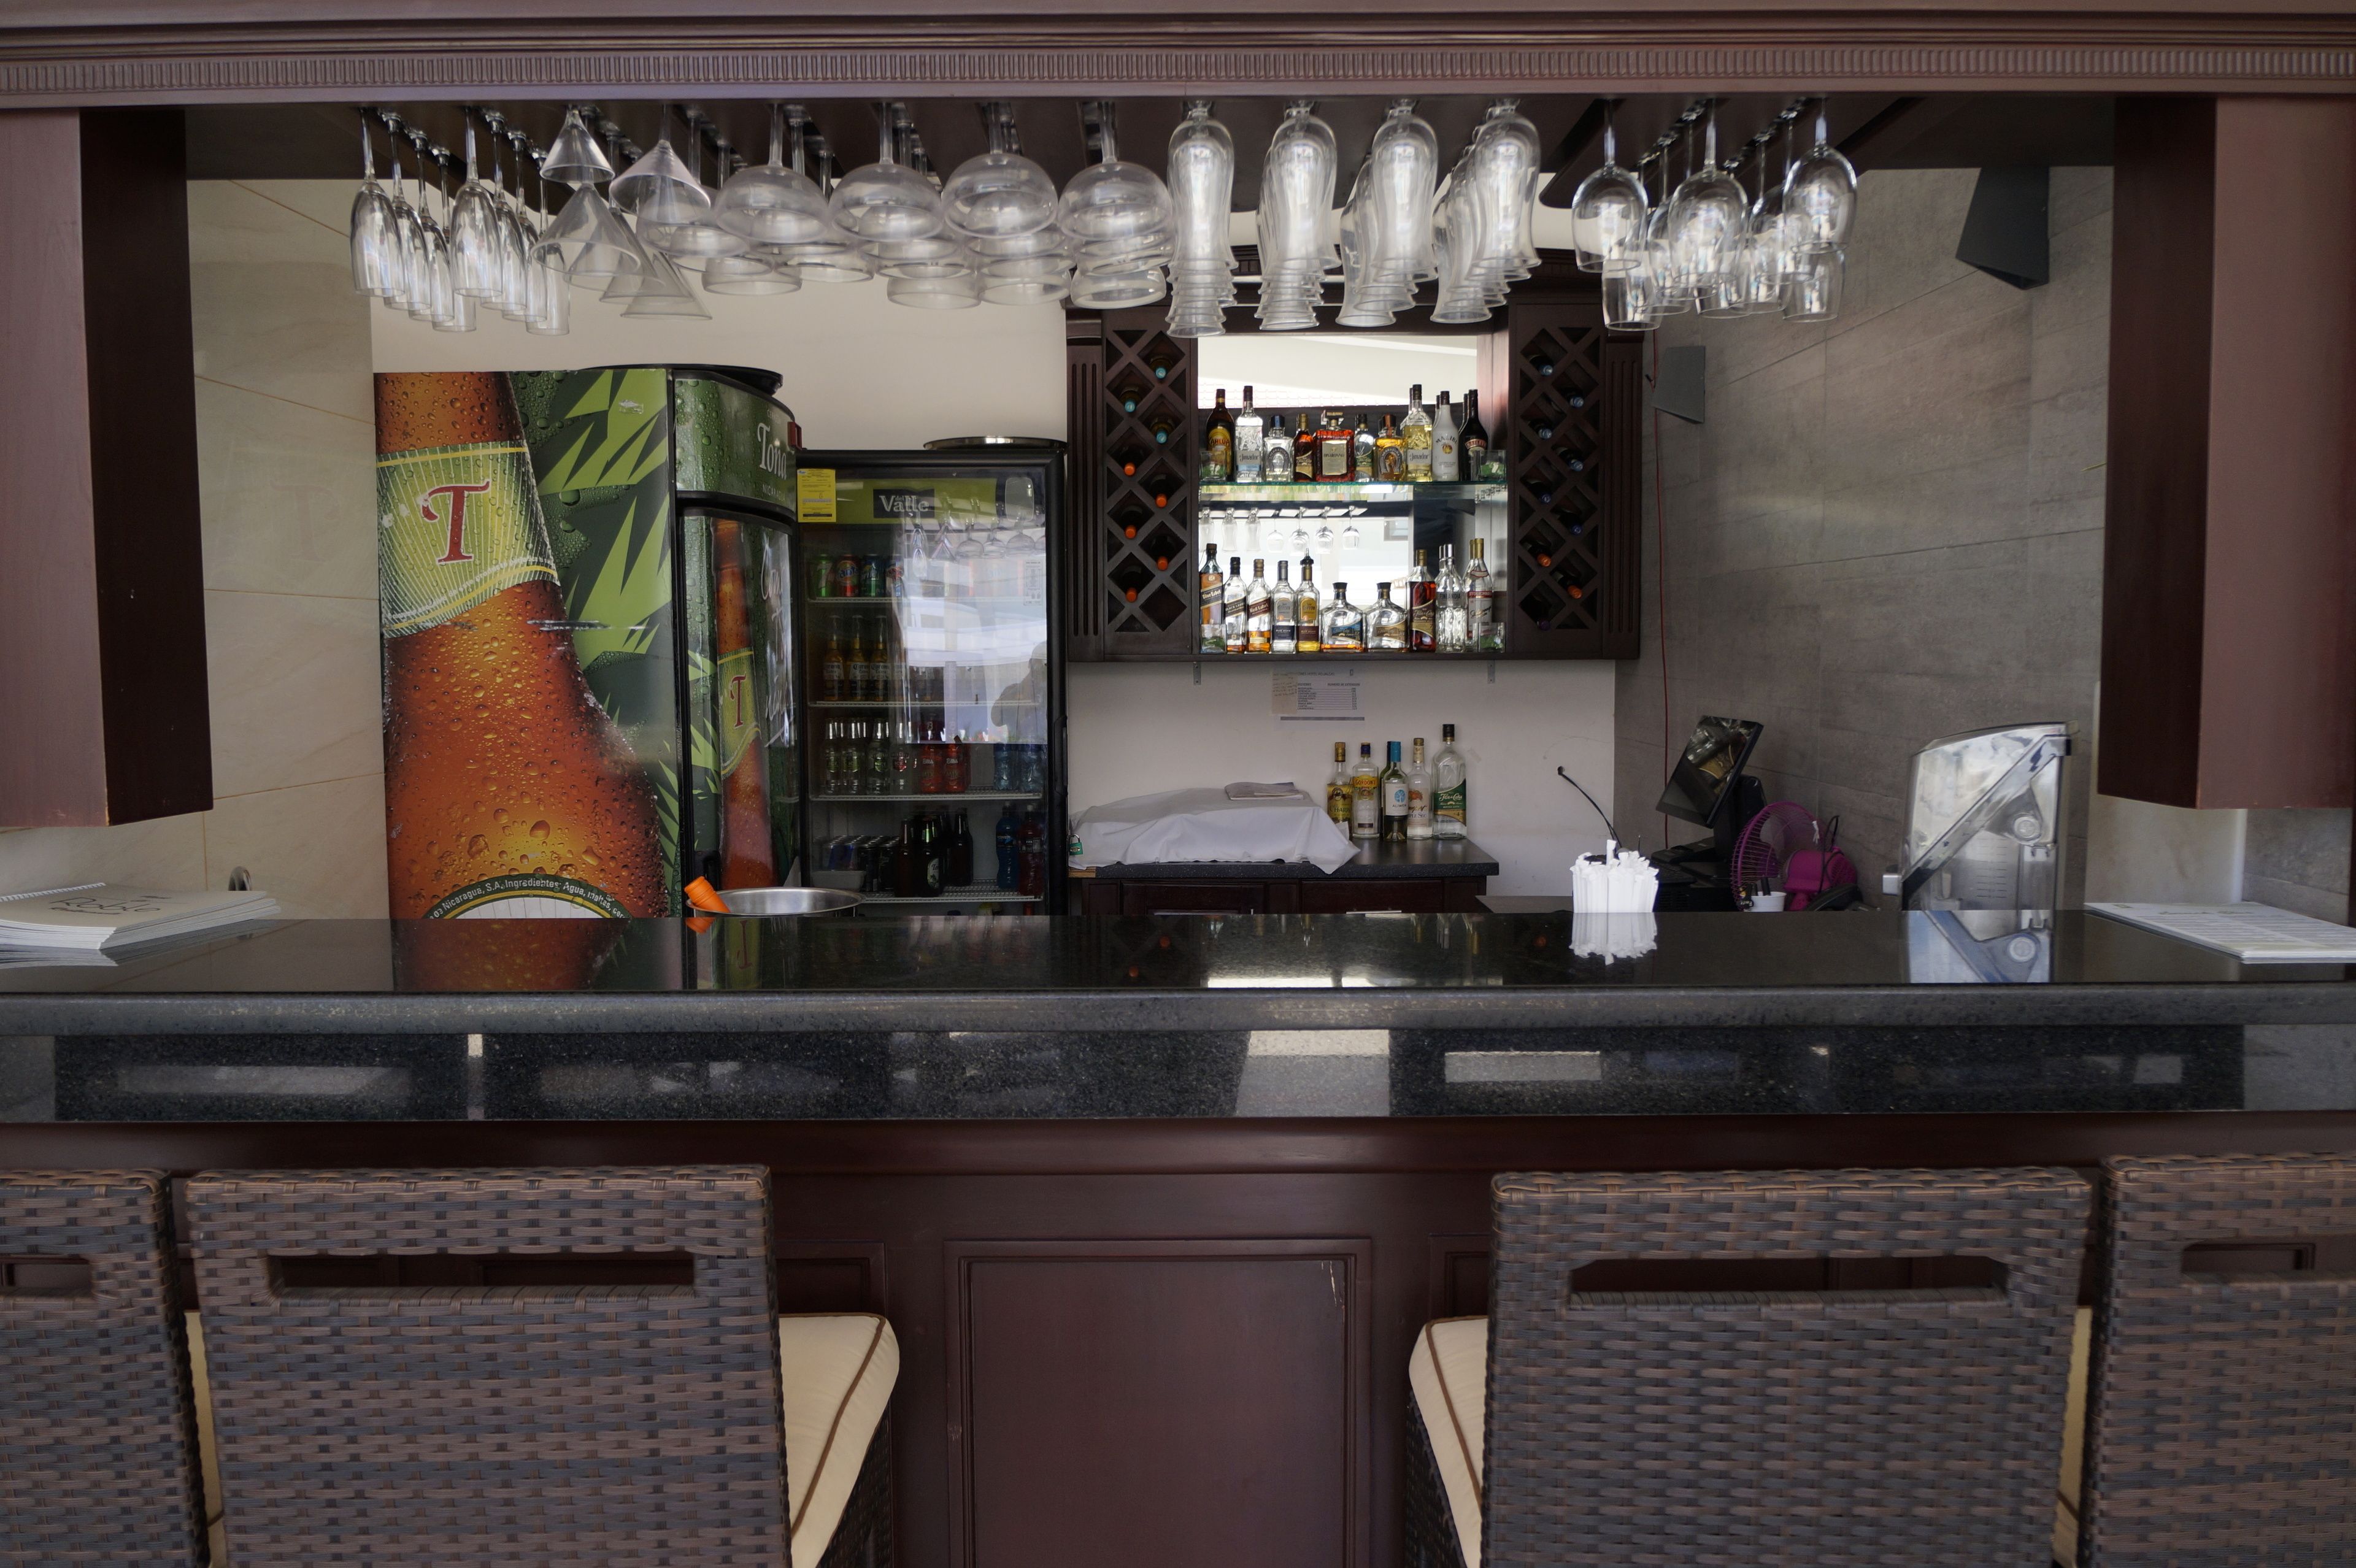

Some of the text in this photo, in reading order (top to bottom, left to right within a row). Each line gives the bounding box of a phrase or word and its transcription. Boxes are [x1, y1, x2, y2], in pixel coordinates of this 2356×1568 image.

[419, 479, 491, 565] T
[879, 495, 930, 512] Valle
[729, 675, 747, 730] T
[443, 887, 485, 911] Nicaragua,
[486, 880, 504, 892] S.A.
